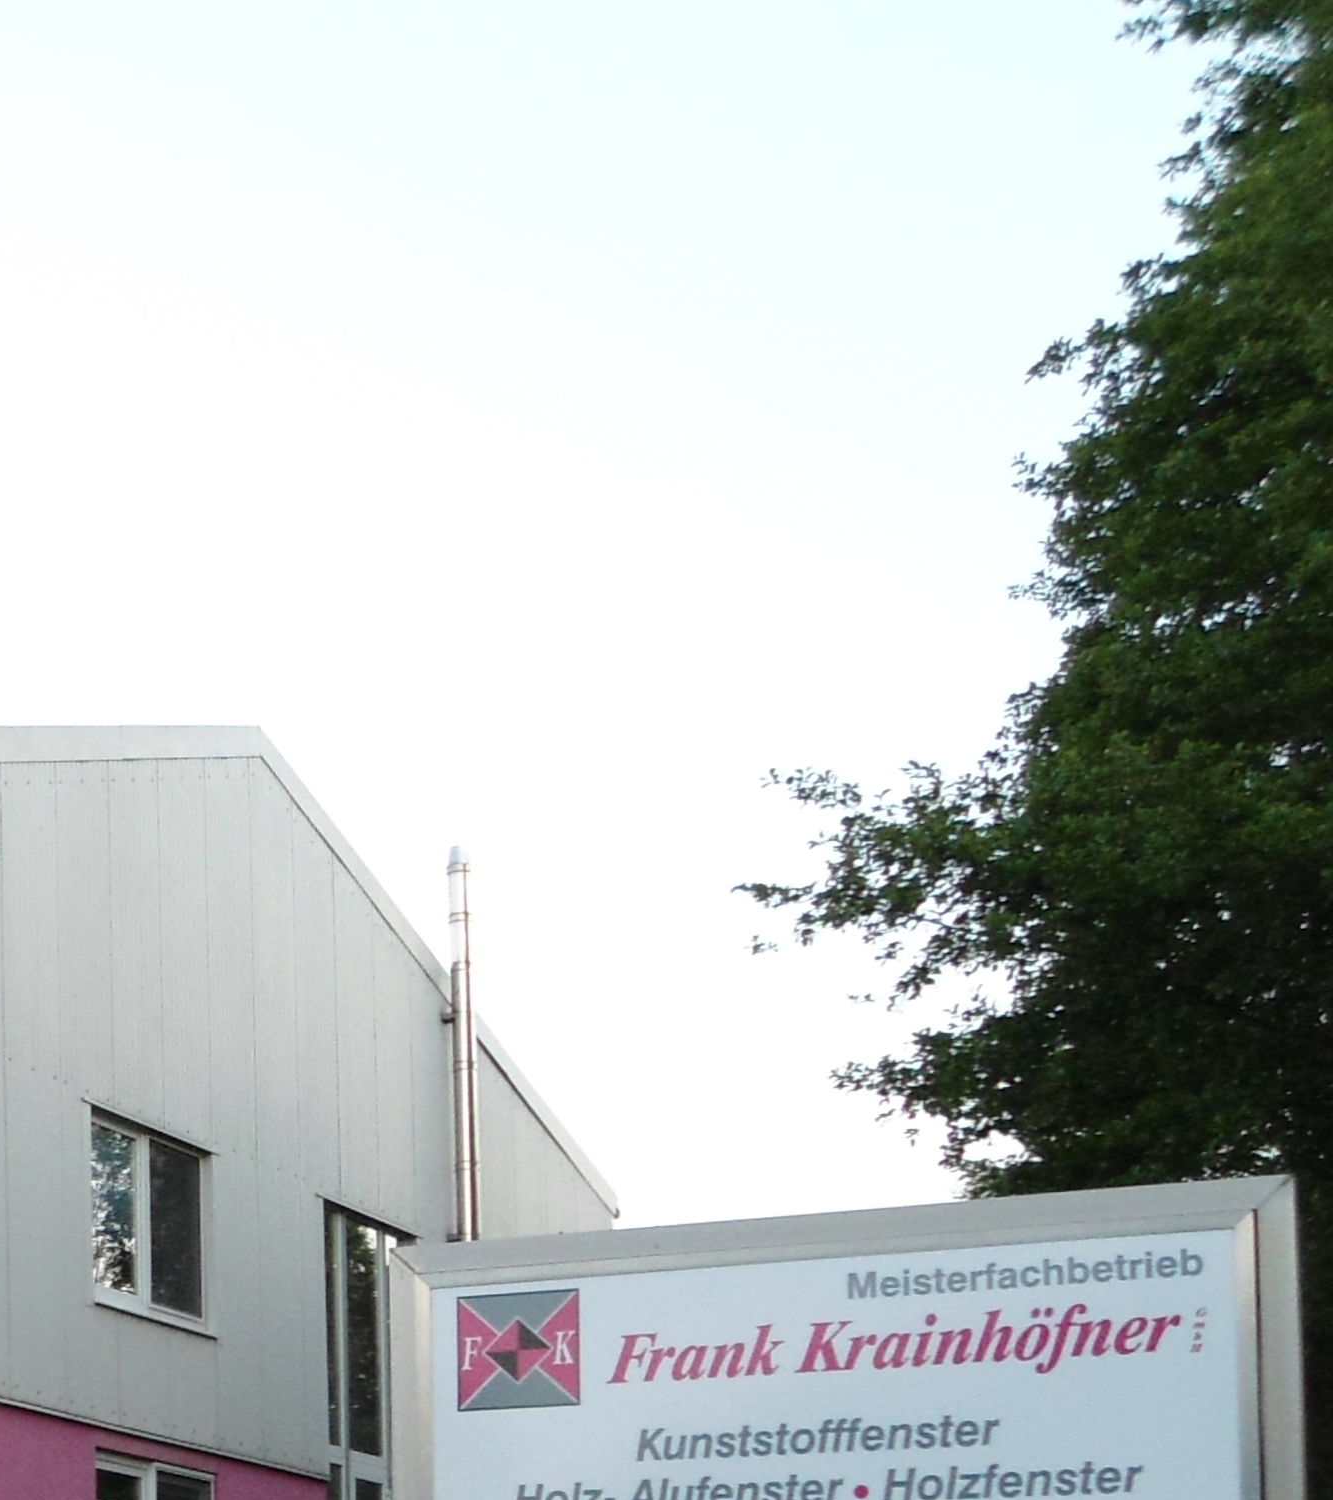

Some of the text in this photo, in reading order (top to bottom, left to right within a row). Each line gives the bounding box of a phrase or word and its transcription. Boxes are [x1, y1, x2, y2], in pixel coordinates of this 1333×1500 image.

[847, 1249, 1204, 1300] Meisterfachbetrieb
[461, 1330, 576, 1371] F K
[606, 1303, 1182, 1385] Frank Krainhöfner
[636, 1416, 1000, 1462] Kunststofffenster
